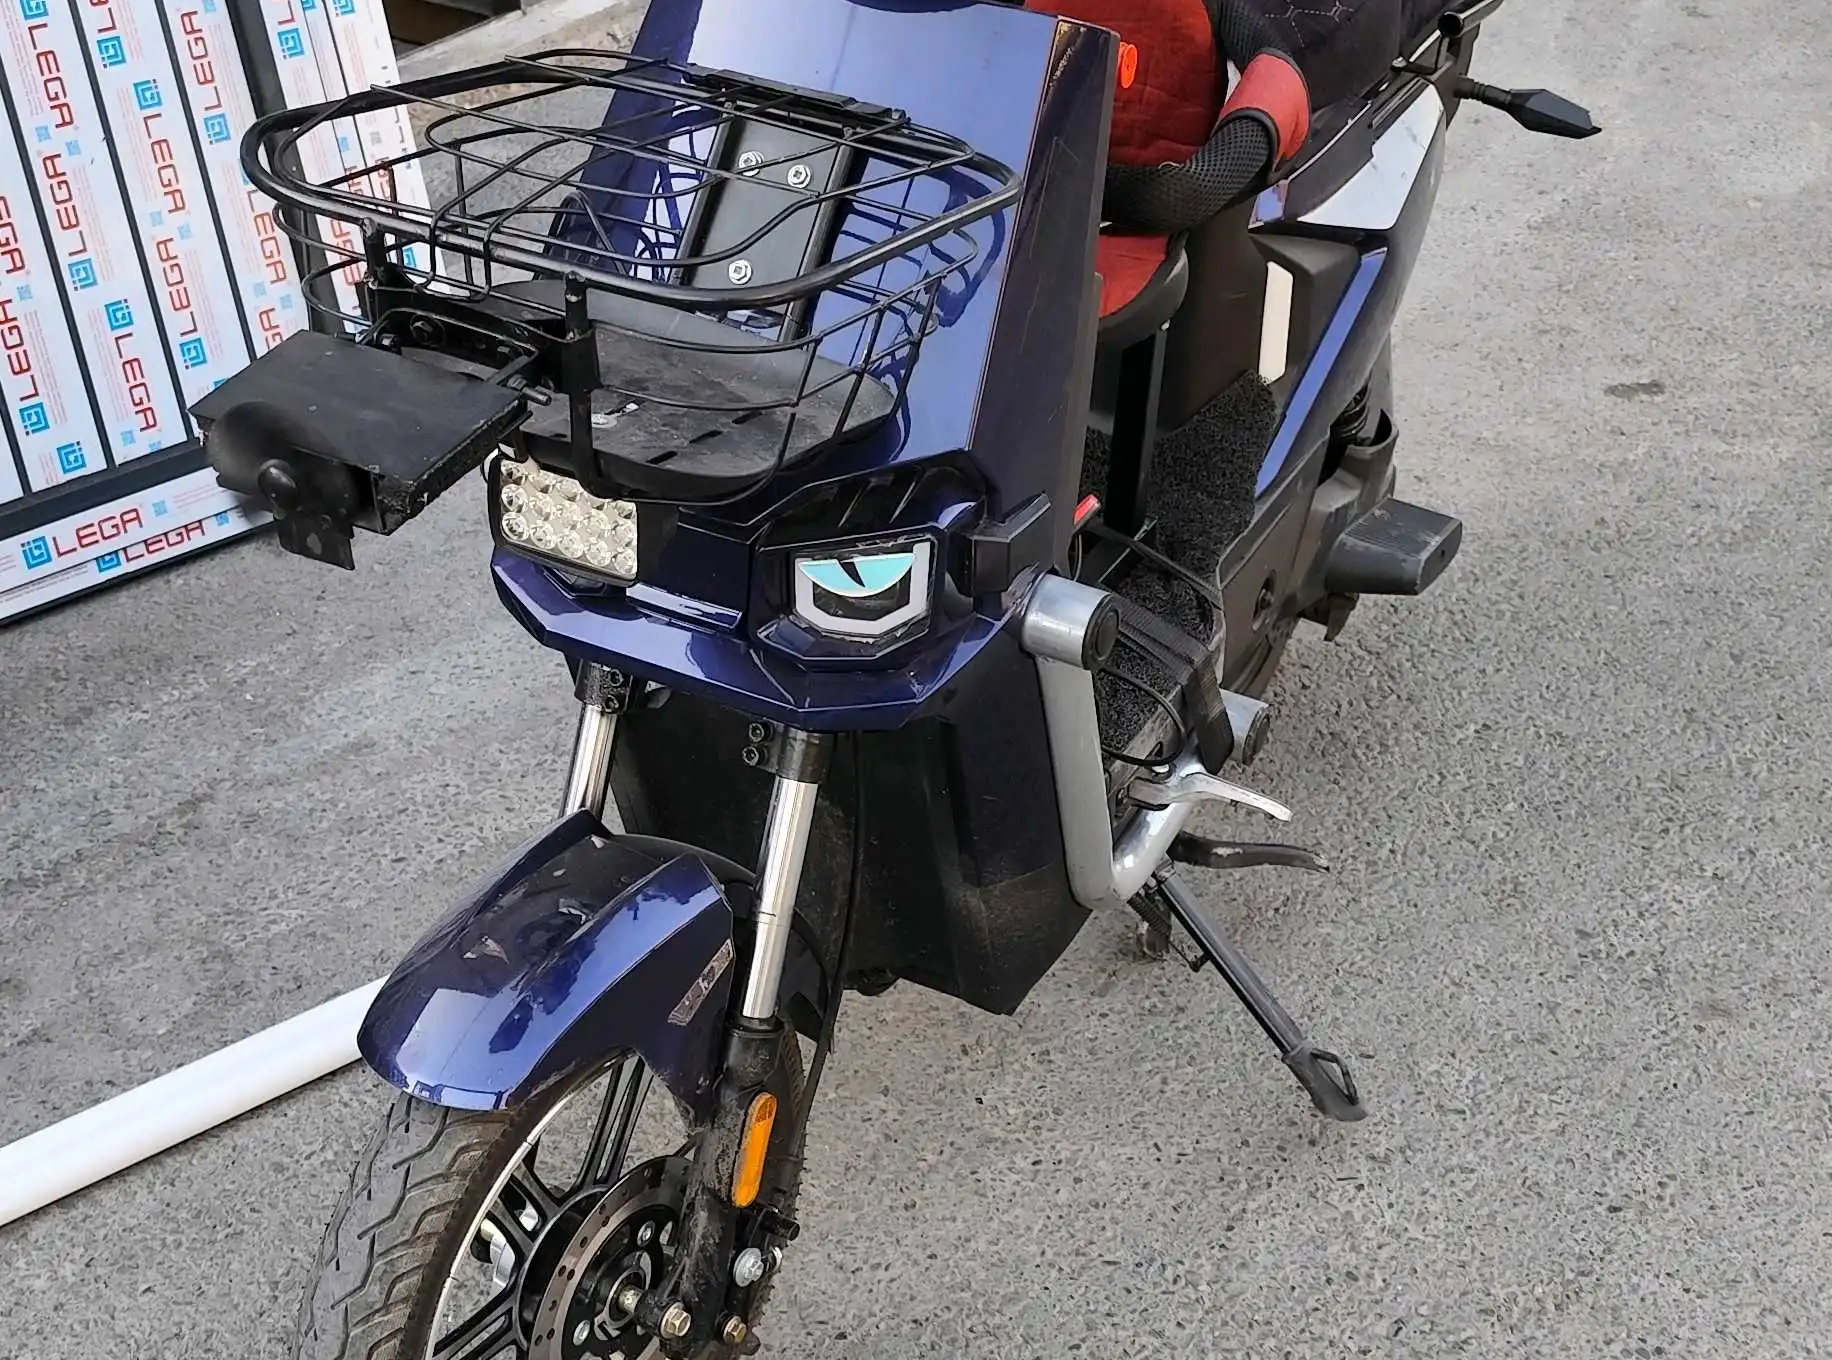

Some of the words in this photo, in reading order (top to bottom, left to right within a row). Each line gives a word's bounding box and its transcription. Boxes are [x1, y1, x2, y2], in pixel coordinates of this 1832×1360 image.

[28, 22, 74, 130] LEGA
[180, 10, 222, 112] LEGA
[42, 153, 88, 258] LEGA
[143, 112, 187, 215] LEGA
[156, 237, 199, 338] LEGA
[247, 188, 288, 286] LEGA
[0, 298, 40, 403] LEGA
[115, 332, 159, 433] LEGA
[52, 506, 144, 558] LEGA
[123, 520, 206, 564] LEGA
